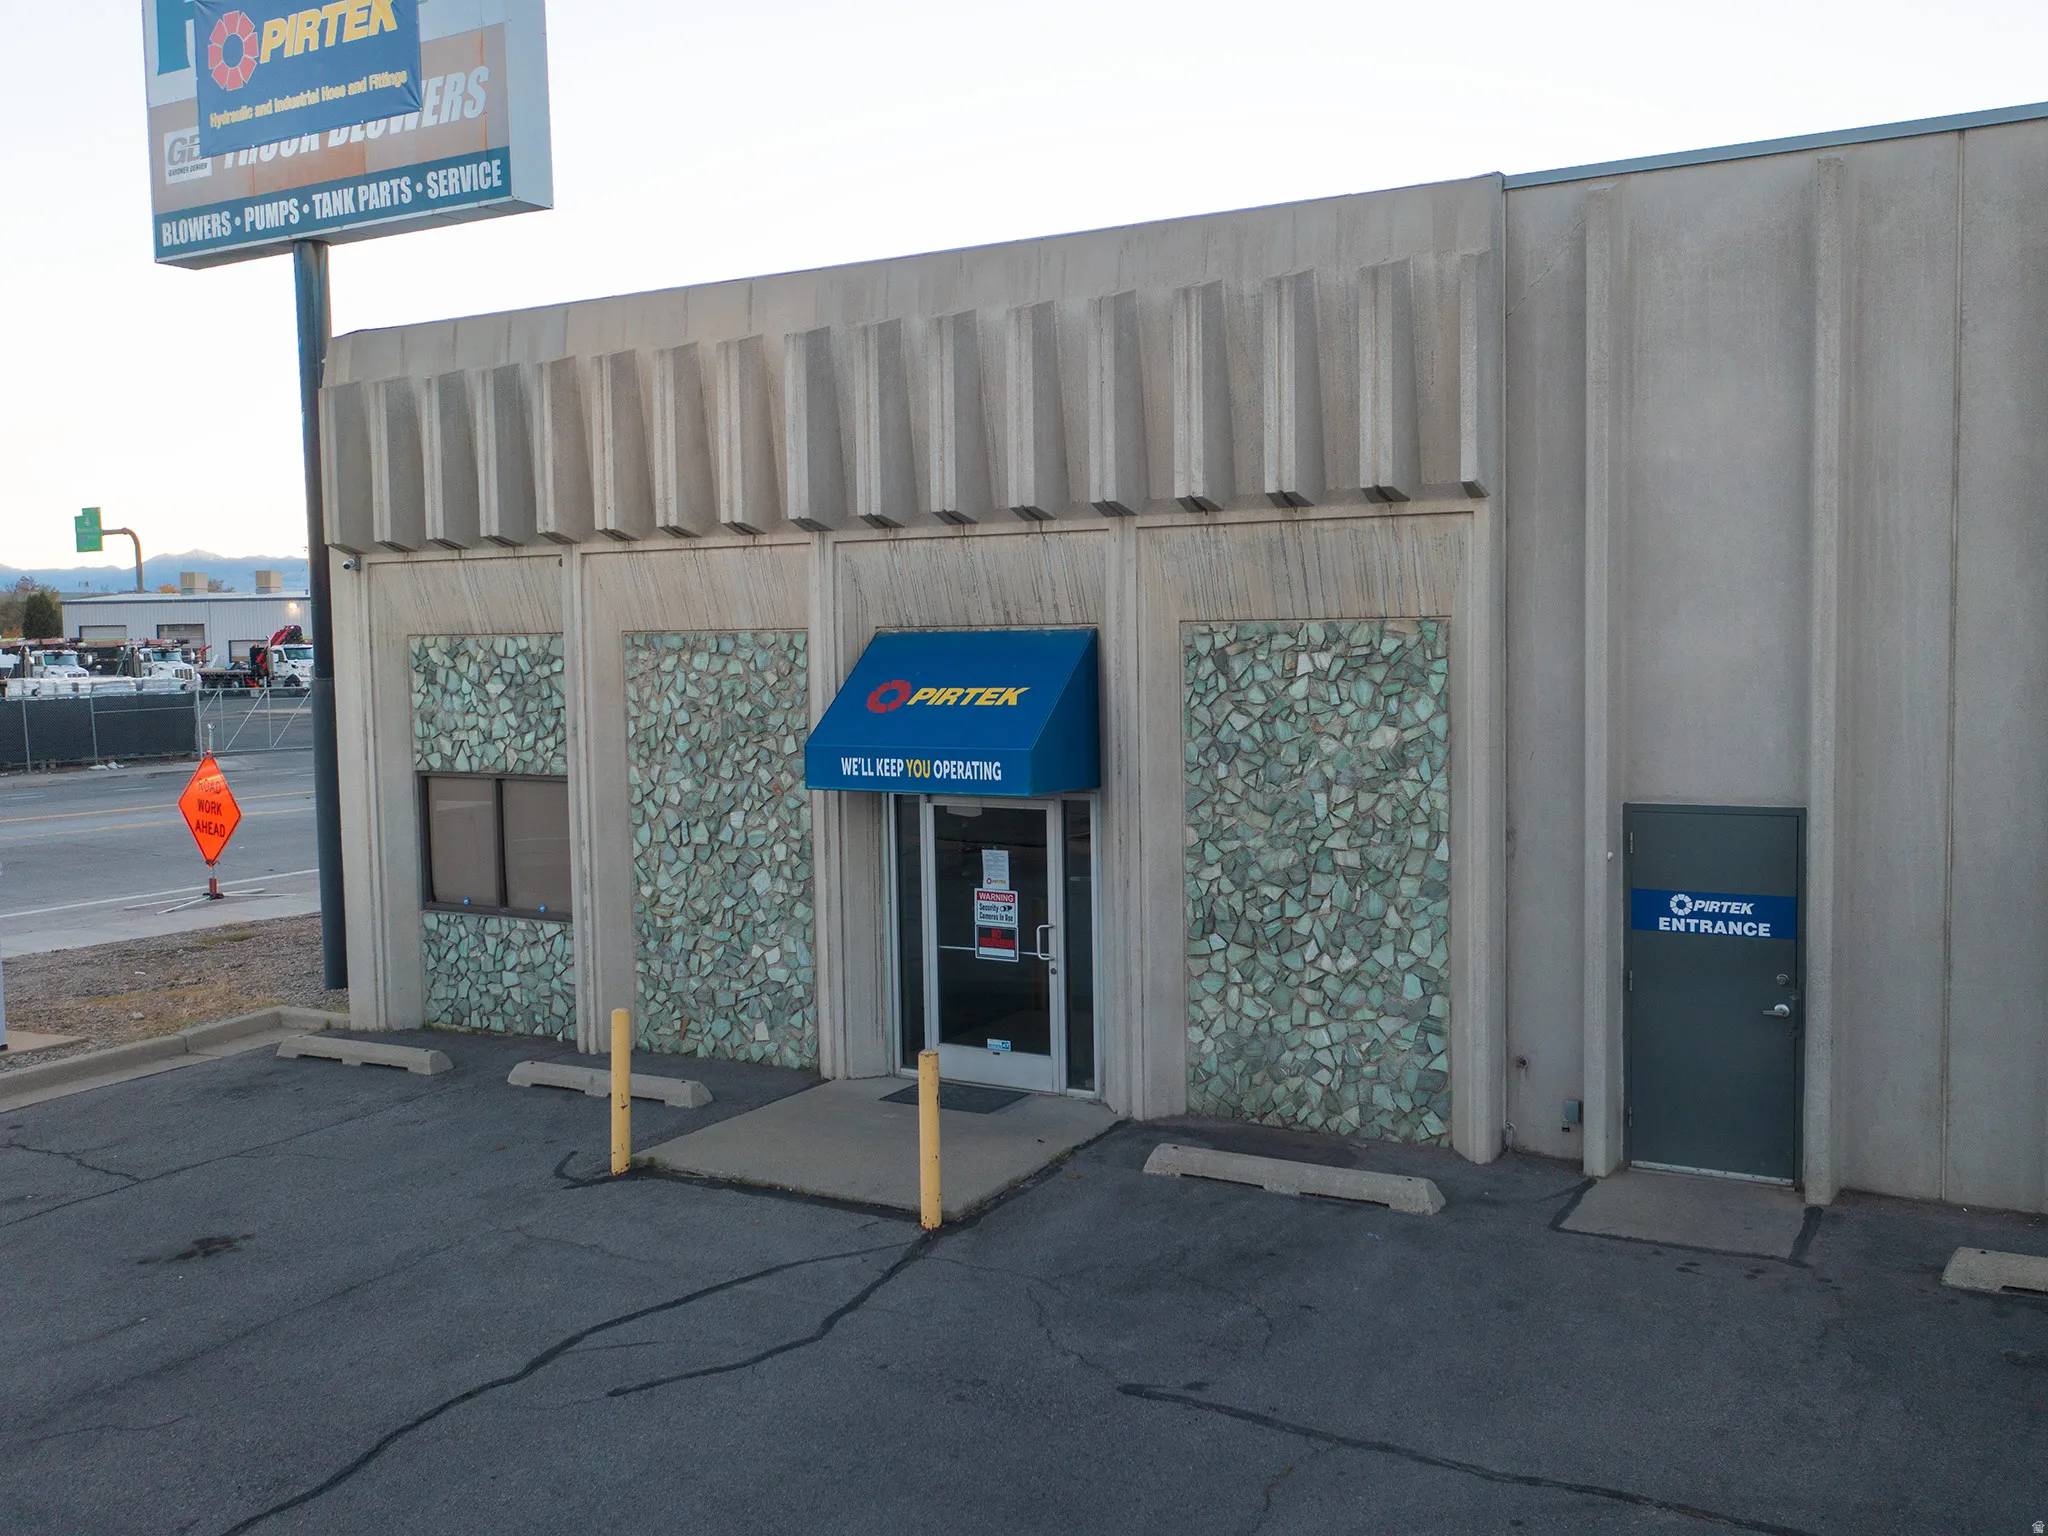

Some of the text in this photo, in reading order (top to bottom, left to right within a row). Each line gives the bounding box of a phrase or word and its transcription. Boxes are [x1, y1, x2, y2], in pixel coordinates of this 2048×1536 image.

[260, 0, 398, 64] PIRTEK
[209, 69, 408, 129] Hydraulic and Industrial Hose and Fittings
[168, 162, 208, 177] GARDNER DENVER
[161, 159, 502, 247] BLOWERS PUMPS TANK PARTS SERVICE
[907, 687, 1030, 706] PIRTEK
[841, 757, 1002, 781] WE'LL KEEP YOU OPERATING
[197, 778, 221, 794] ROAD
[197, 799, 222, 816] WORK
[195, 819, 226, 837] AHEAD
[978, 892, 1014, 902] WARNING
[979, 903, 999, 913] Security
[1692, 900, 1755, 915] PIRTEK
[979, 912, 998, 920] Cameras
[1005, 914, 1013, 922] Use
[1659, 917, 1771, 937] ENTRANCE
